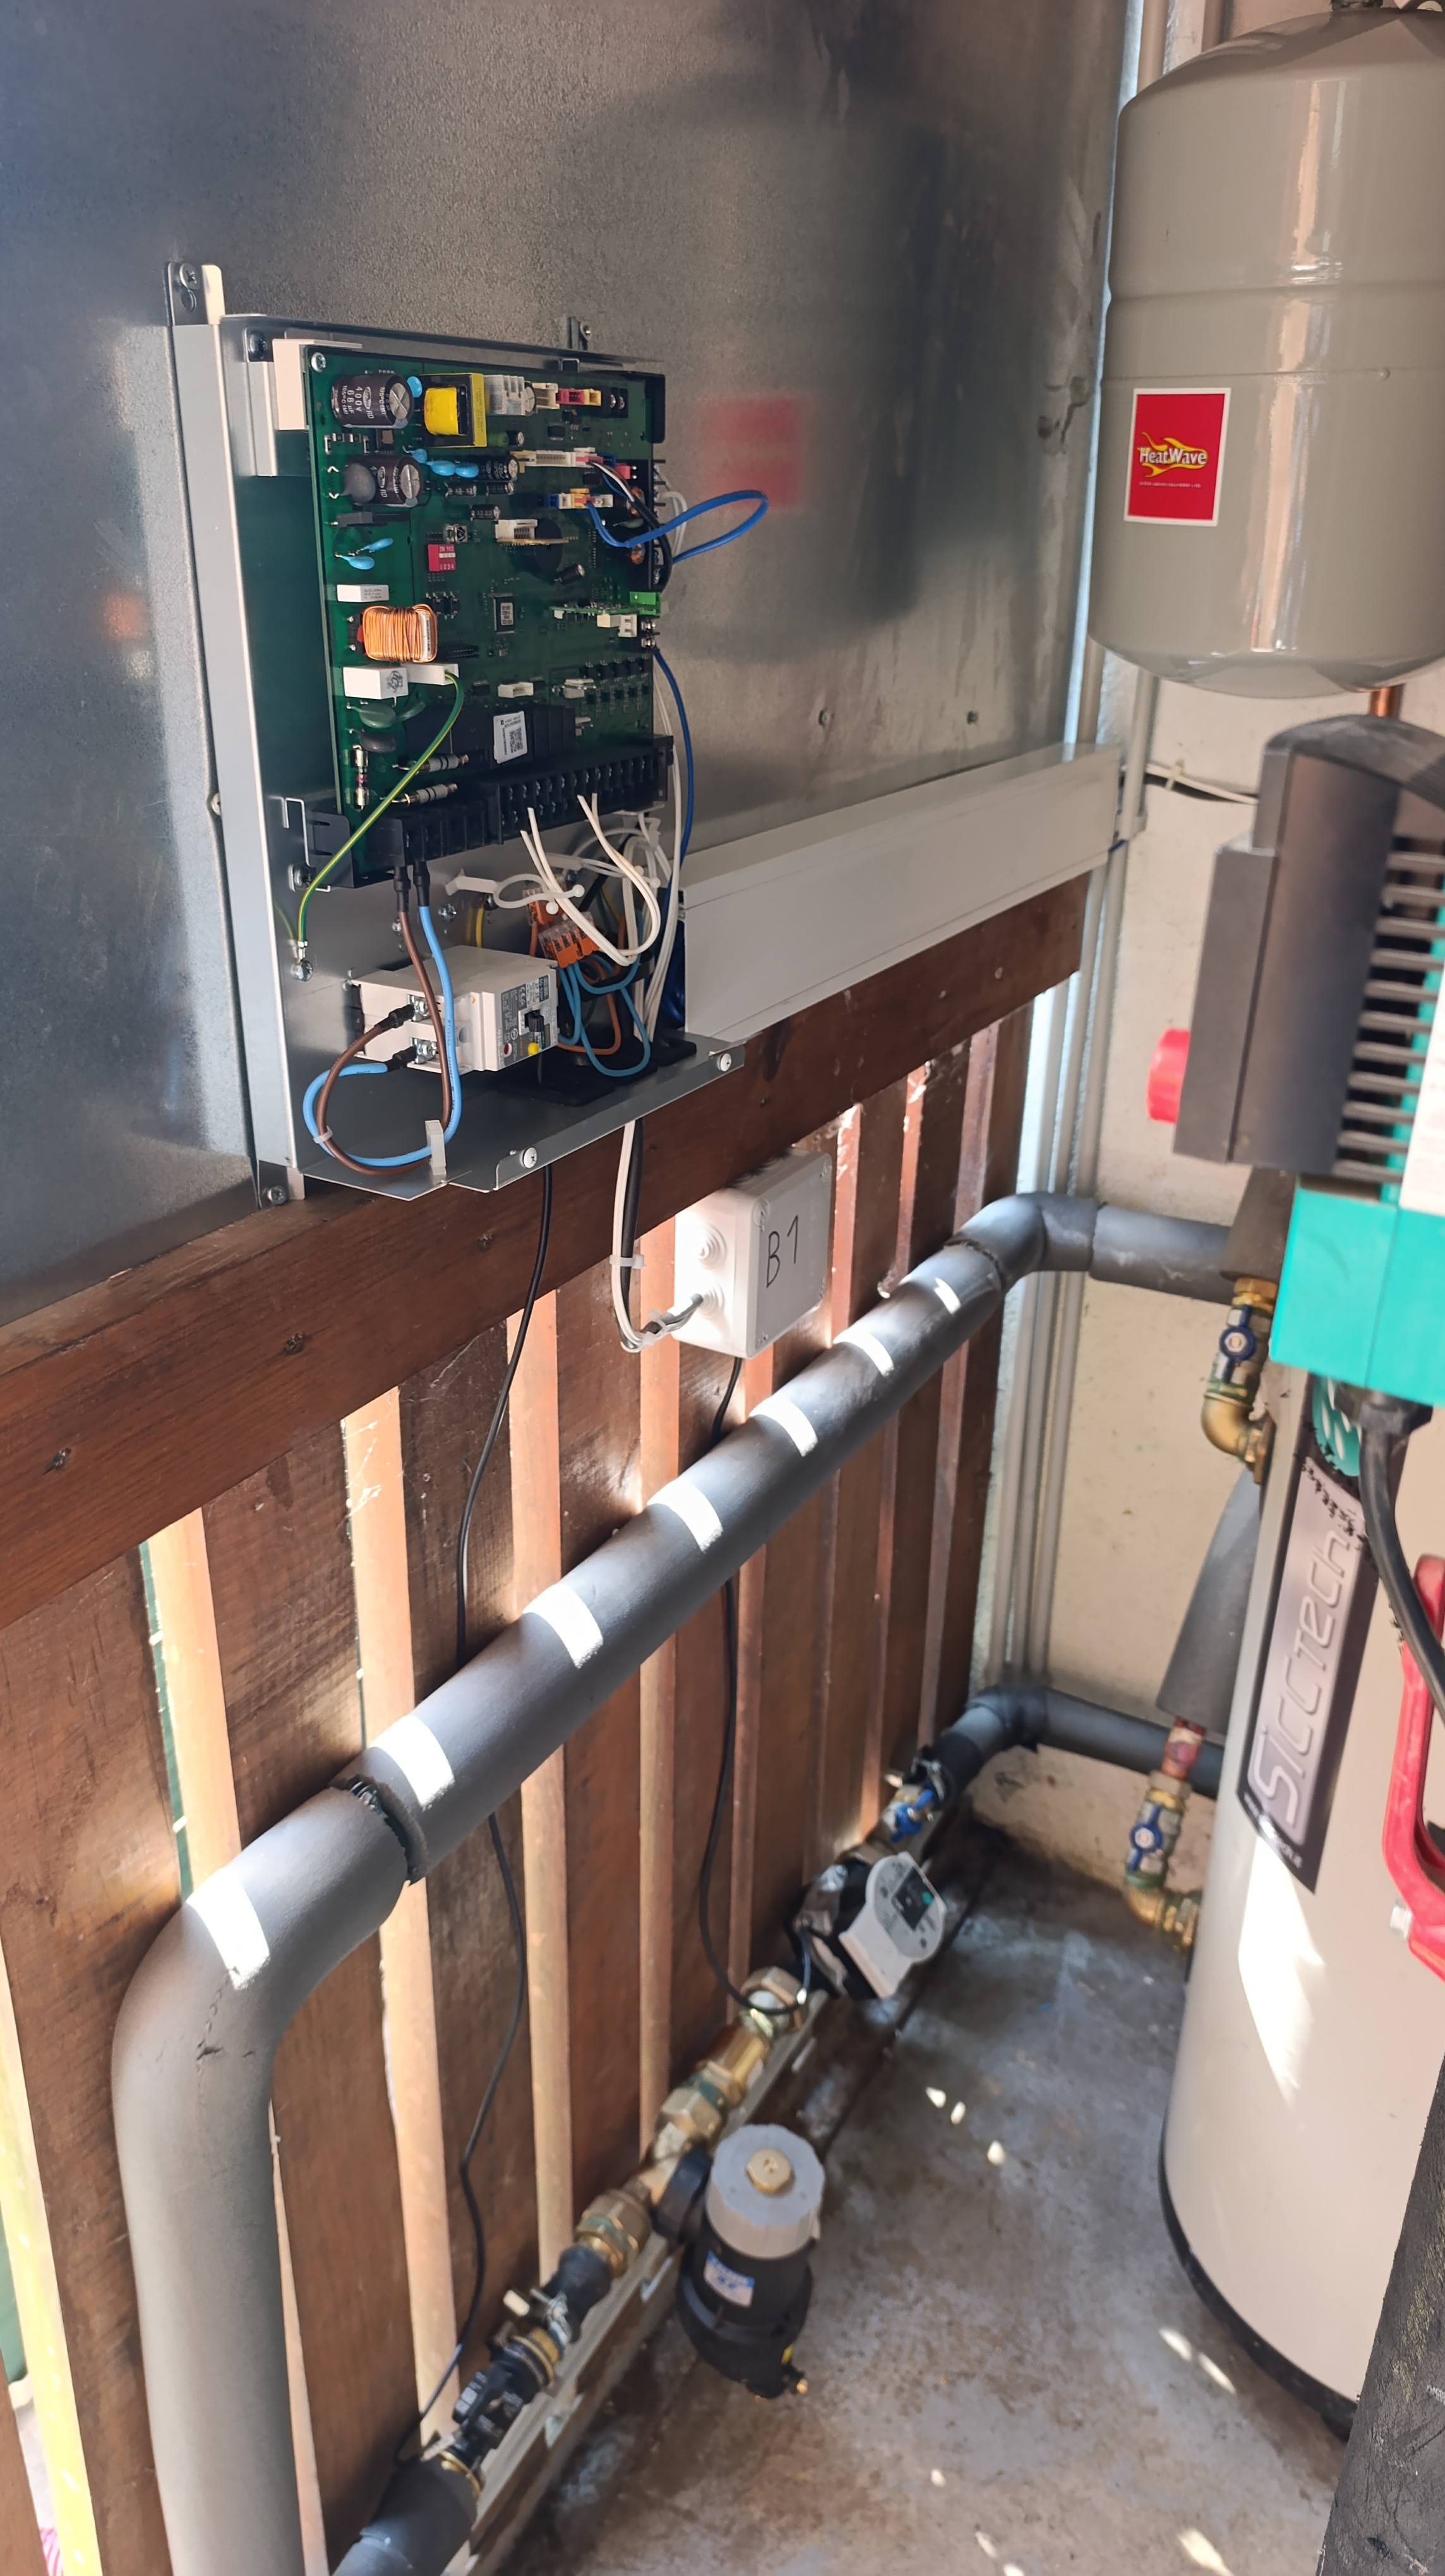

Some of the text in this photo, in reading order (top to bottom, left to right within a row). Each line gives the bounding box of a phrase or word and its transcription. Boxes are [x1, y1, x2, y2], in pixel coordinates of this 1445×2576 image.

[347, 390, 354, 403] 68
[366, 410, 374, 419] RD
[1139, 446, 1208, 465] HeatWave
[765, 1214, 799, 1289] B1
